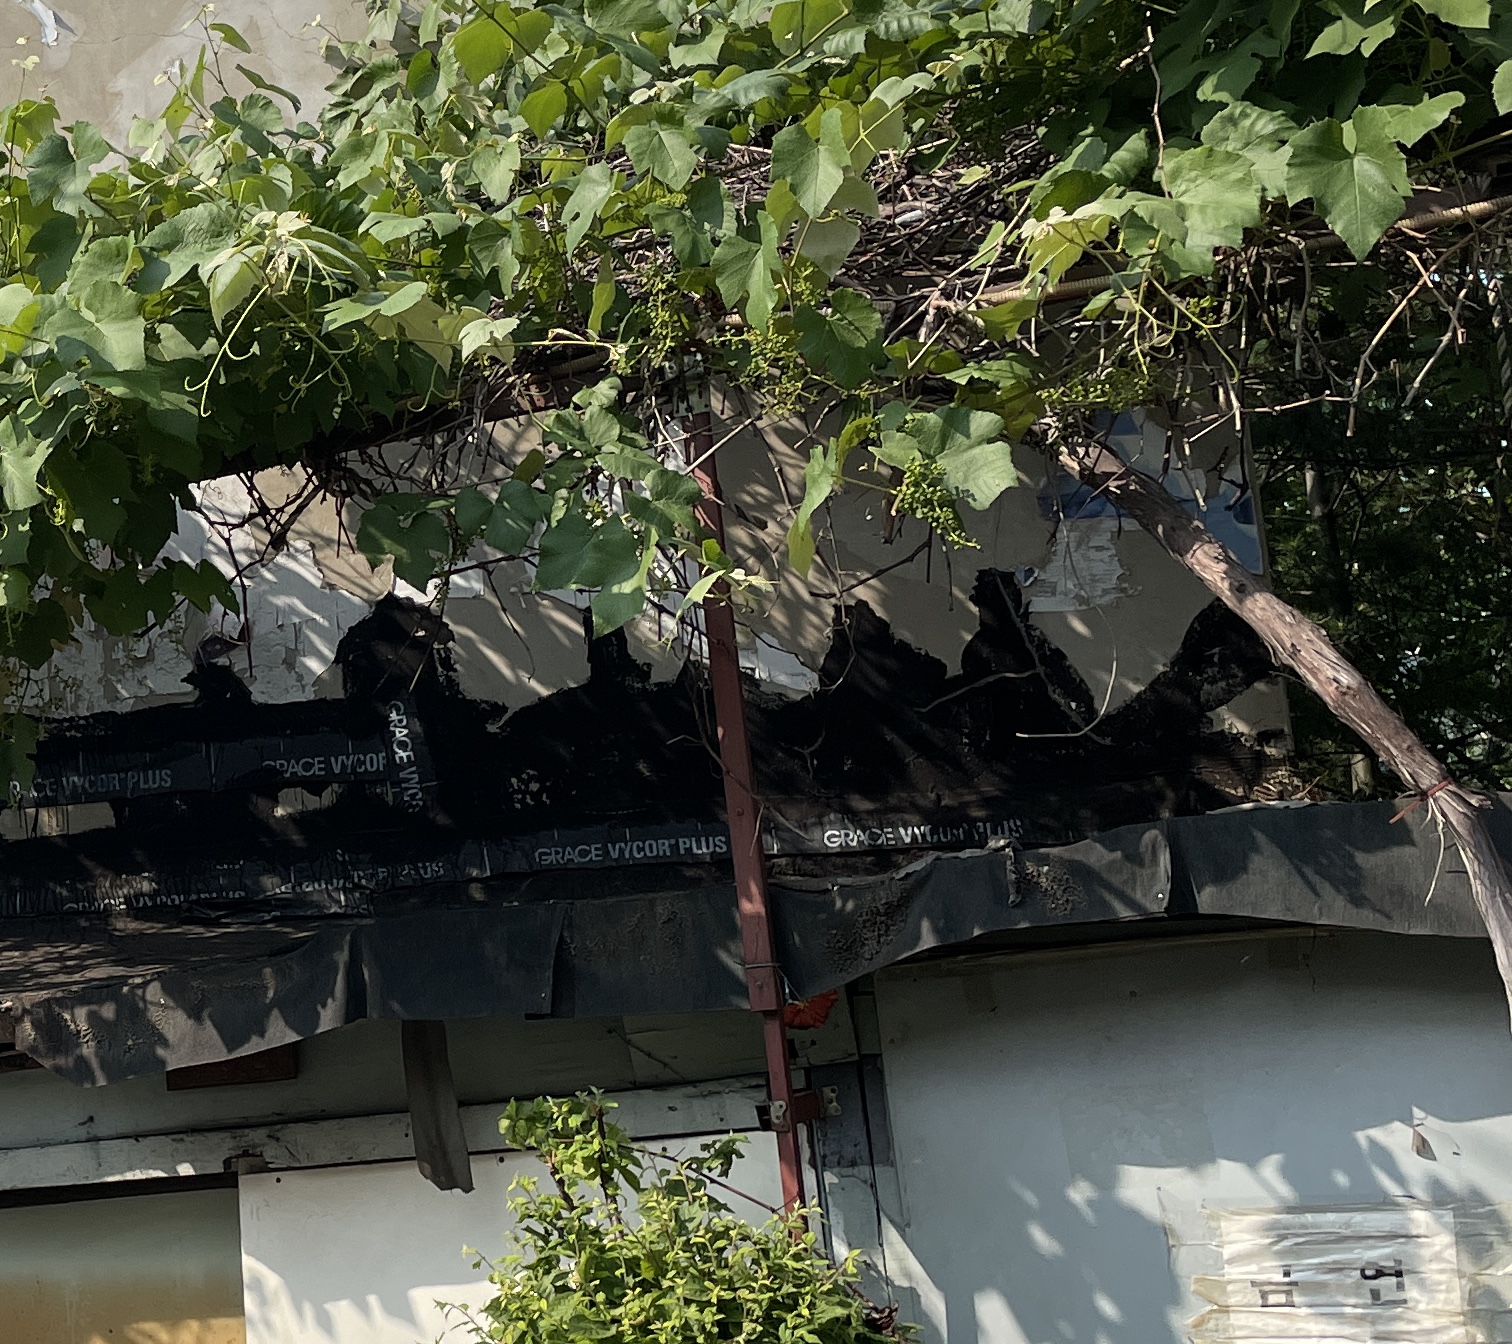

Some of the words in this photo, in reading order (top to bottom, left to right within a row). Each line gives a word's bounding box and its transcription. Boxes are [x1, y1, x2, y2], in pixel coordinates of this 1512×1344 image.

[388, 700, 415, 764] GRACE
[128, 769, 172, 791] PLUS
[534, 843, 603, 865] GRACE
[678, 835, 728, 855] PLUS
[823, 827, 896, 848] GRACE
